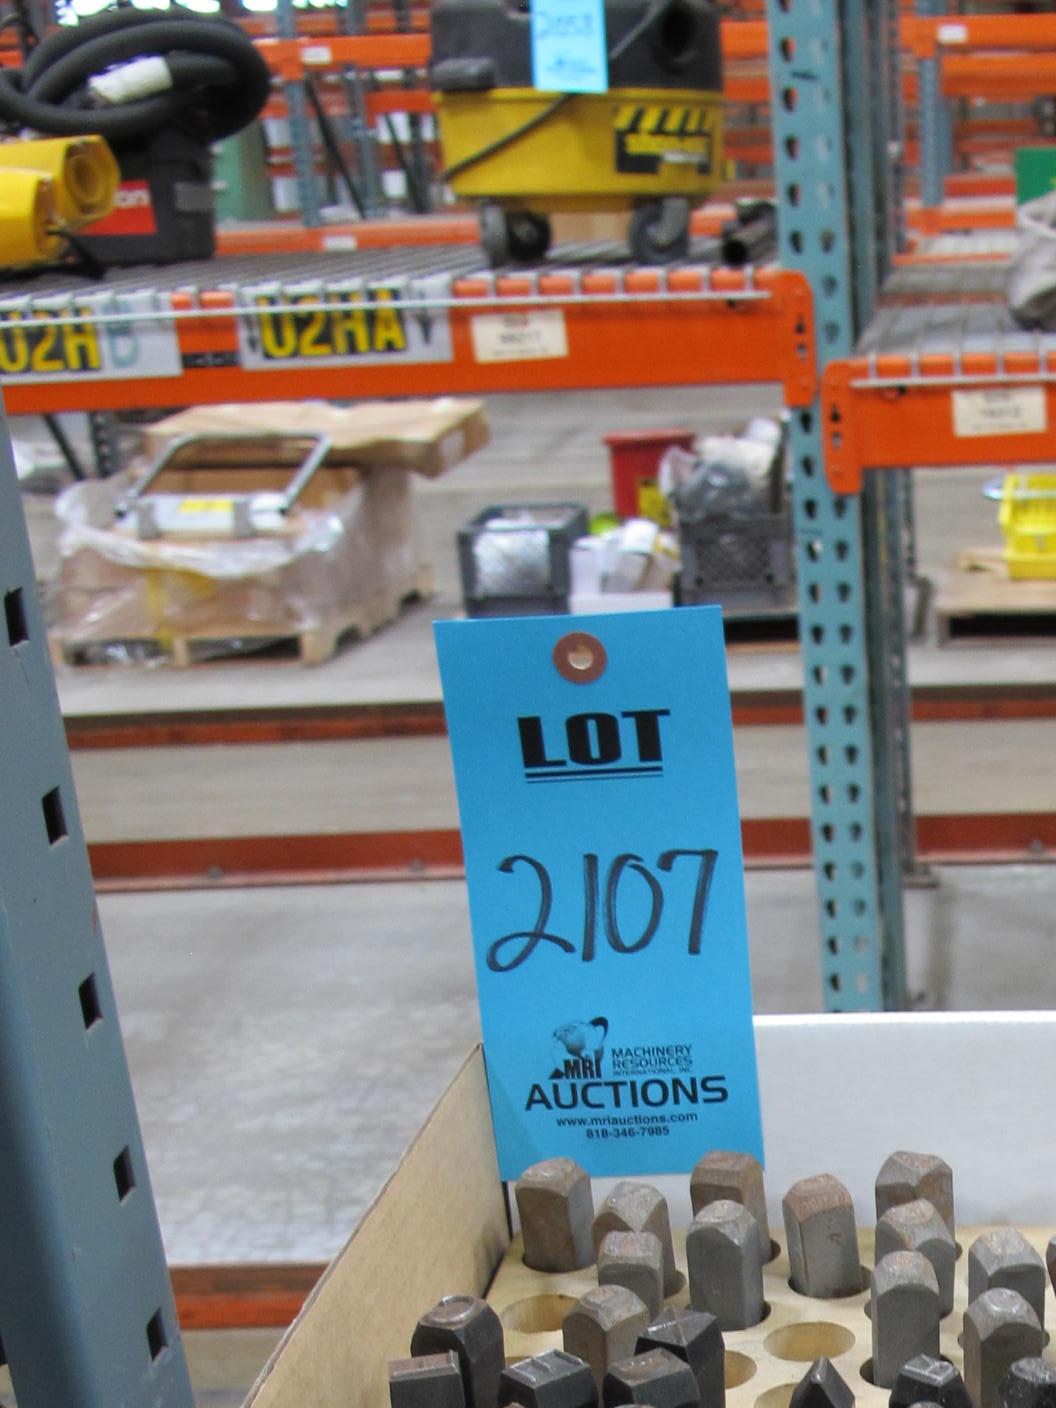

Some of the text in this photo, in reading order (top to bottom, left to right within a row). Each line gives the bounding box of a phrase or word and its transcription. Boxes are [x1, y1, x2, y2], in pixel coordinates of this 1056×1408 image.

[516, 708, 671, 768] LOT
[486, 848, 719, 973] 2107
[611, 1044, 693, 1059] MACHINERY
[562, 1056, 602, 1079] MRI
[612, 1056, 694, 1070] RESOURCES
[524, 1074, 730, 1112] AUCTIONS
[556, 1111, 699, 1128] www.mriauctions.com
[586, 1125, 671, 1140] 818-346-7985
